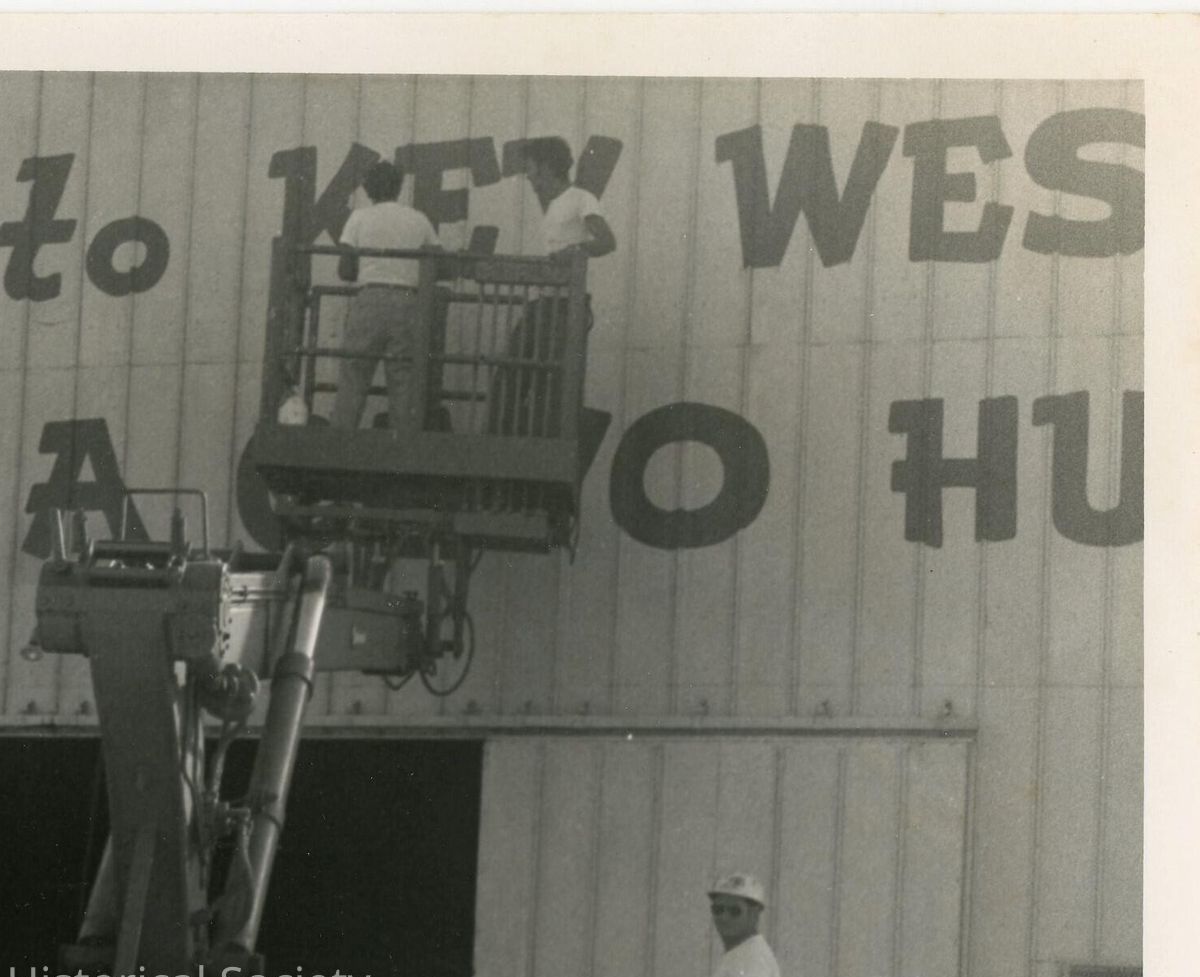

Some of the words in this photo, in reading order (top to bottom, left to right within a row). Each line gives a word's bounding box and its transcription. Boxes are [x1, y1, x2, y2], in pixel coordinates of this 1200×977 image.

[714, 107, 1145, 268] WES
[21, 417, 150, 557] A
[889, 390, 1145, 548] HU
